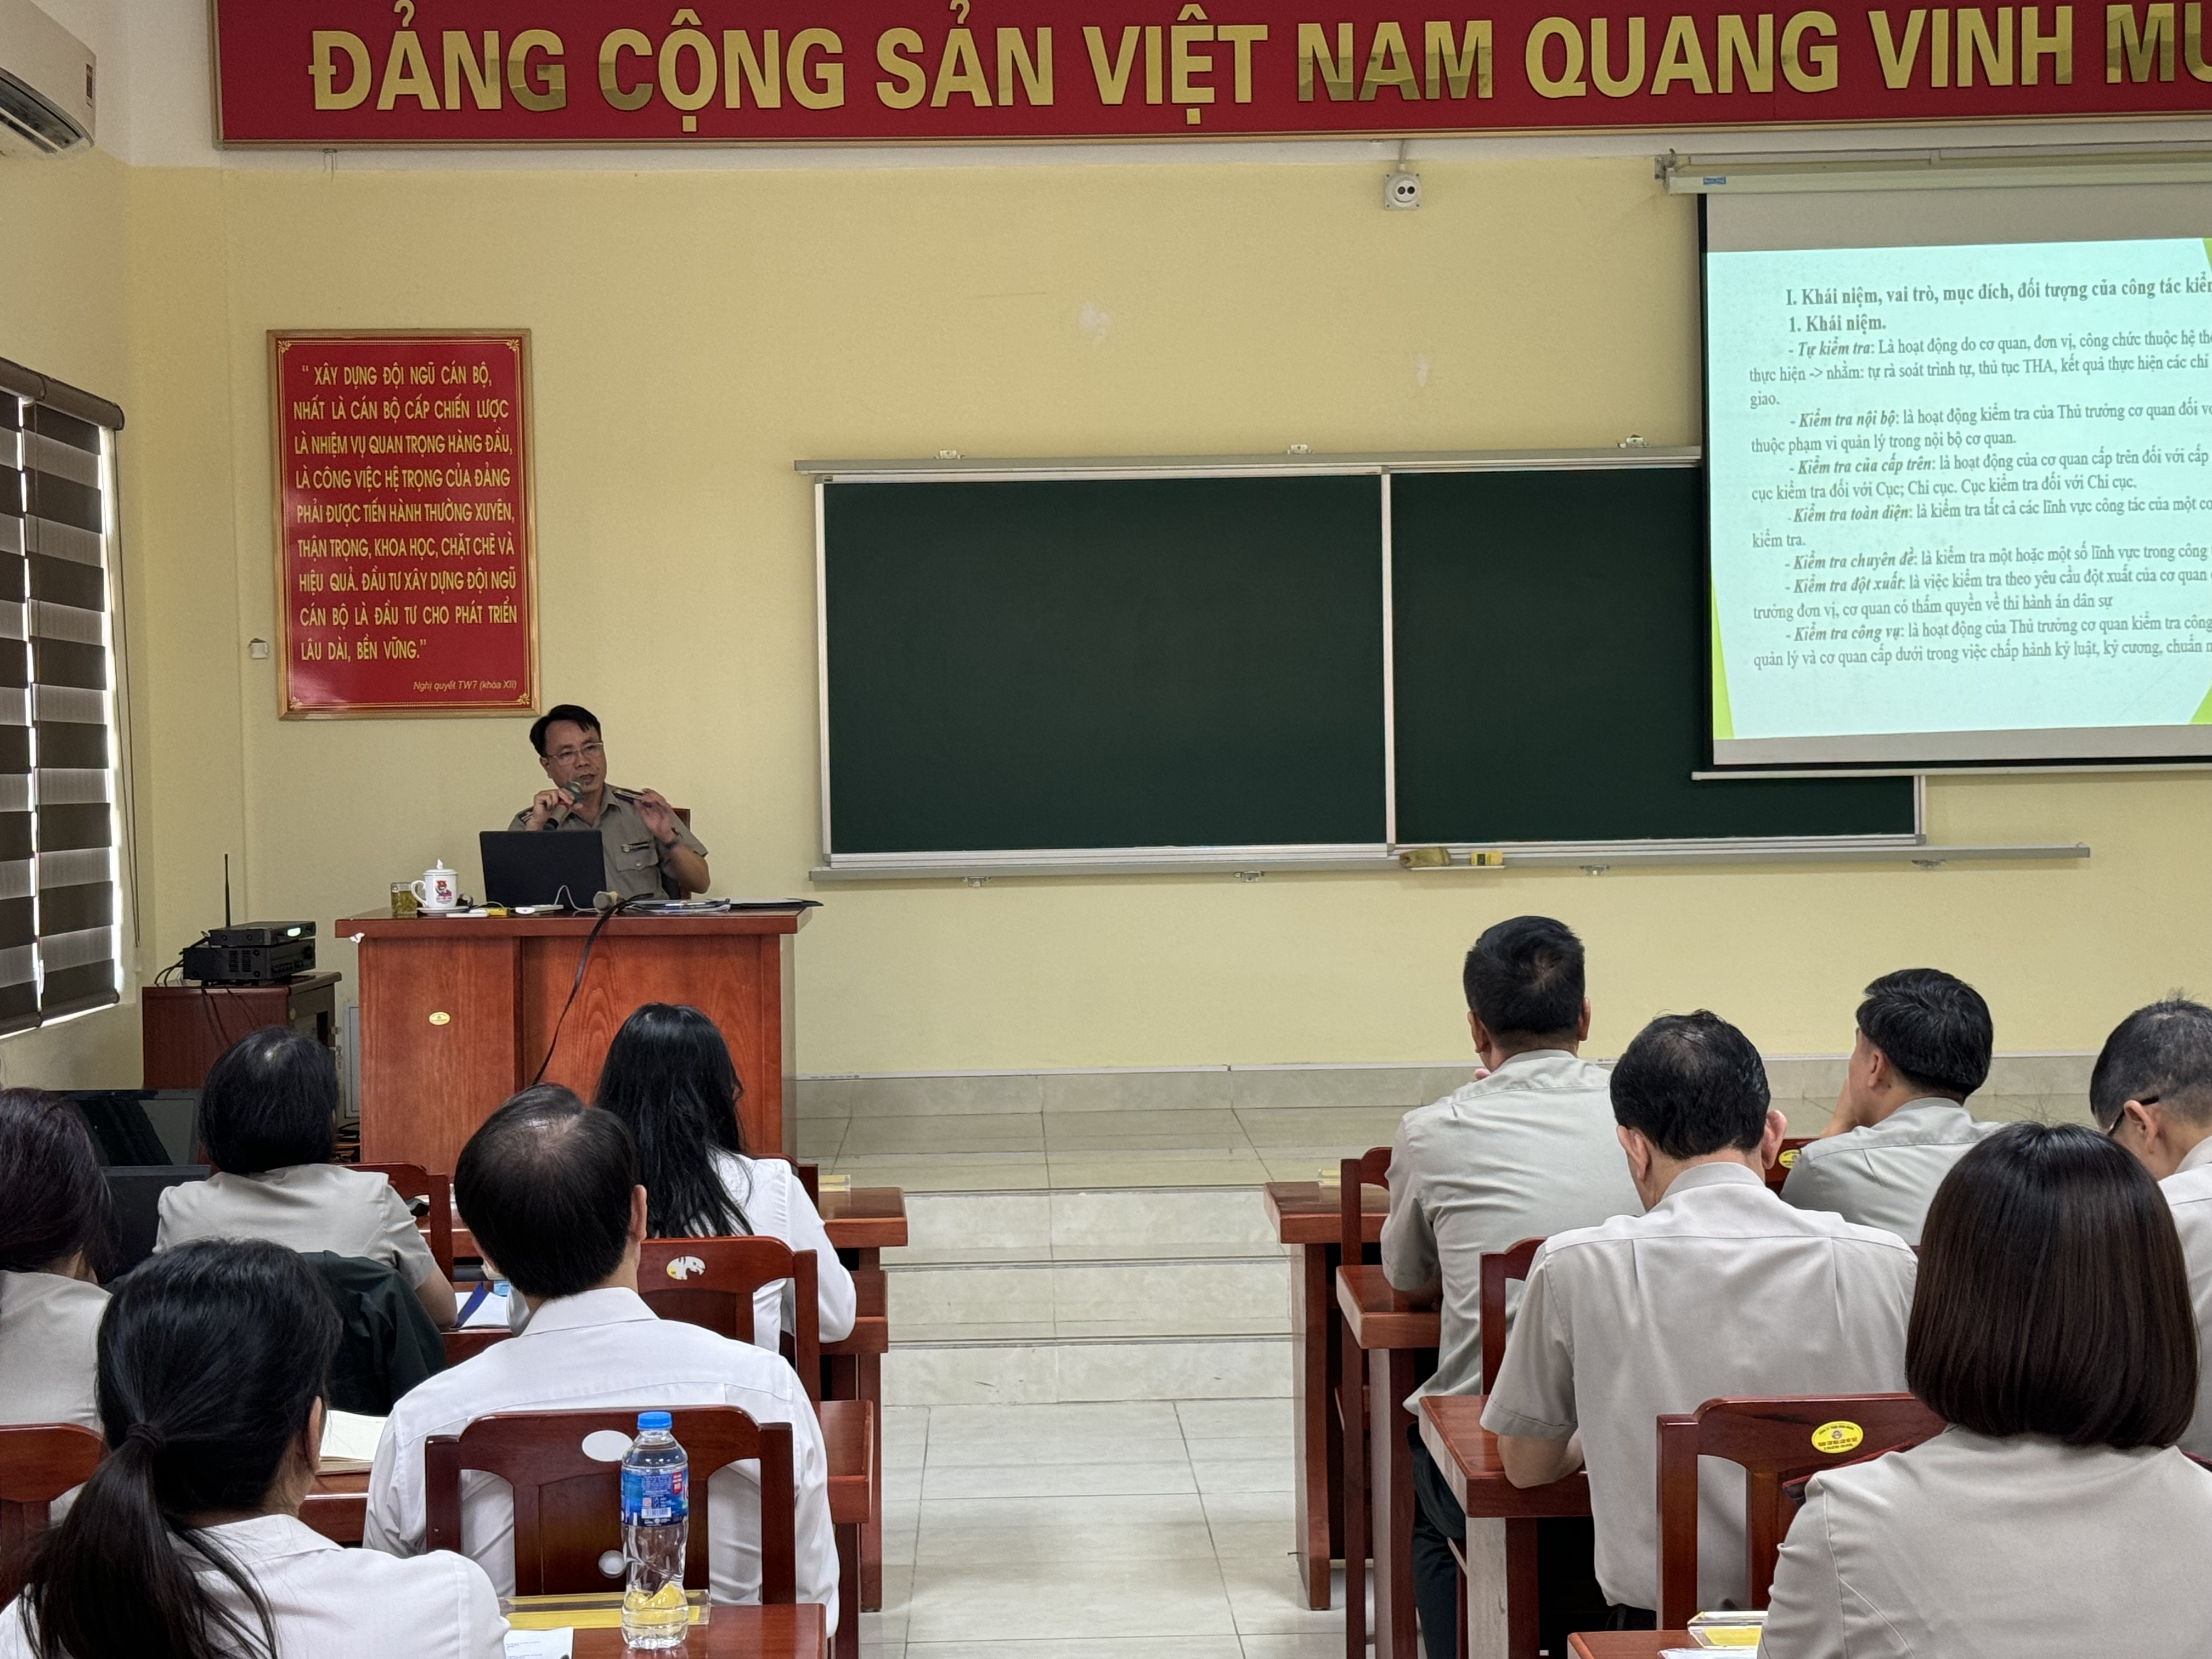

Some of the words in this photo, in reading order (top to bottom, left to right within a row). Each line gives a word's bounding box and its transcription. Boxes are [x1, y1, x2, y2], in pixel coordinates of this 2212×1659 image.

[308, 0, 566, 111] ĐẢNG
[599, 9, 844, 132] CỘNG
[876, 0, 1053, 109] SẢN
[1082, 4, 1268, 124] VIỆT
[1299, 20, 1492, 101] NAM
[1526, 11, 1837, 98] QUANG
[1868, 6, 2072, 88] VINH
[1786, 289, 1797, 306] I.
[1802, 288, 1837, 305] Khái
[1842, 286, 1882, 308] niệm,
[1886, 286, 1908, 302] vai
[1913, 285, 1939, 304] trò,
[1943, 289, 1974, 305] mục
[1978, 283, 2013, 302] đích,
[2018, 277, 2040, 298] đối
[2045, 283, 2088, 302] tượng
[2092, 279, 2116, 296] của
[2121, 278, 2155, 299] công
[2160, 278, 2181, 294] tác
[1790, 317, 1801, 332] 1.
[1806, 315, 1842, 332] Khái
[1846, 314, 1886, 335] niệm.
[314, 362, 338, 385] XÂY
[344, 365, 377, 390] DỰNG
[383, 362, 404, 389] ĐỘI
[410, 362, 435, 385] NGŨ
[441, 360, 466, 385] CÁN
[473, 361, 492, 388] BỘ,
[294, 394, 325, 420] NHẤT
[332, 396, 346, 419] LÀ
[351, 395, 377, 419] CÁN
[383, 397, 400, 424] BỘ
[405, 393, 430, 419] CẤP
[435, 393, 470, 419] CHIẾN
[477, 399, 509, 422] LƯỢC
[295, 430, 309, 454] LÀ
[312, 431, 347, 458] NHIỆM
[350, 436, 366, 458] VỤ
[369, 436, 403, 454] QUAN
[405, 435, 445, 458] TRỌNG
[448, 429, 482, 453] HÀNG
[484, 427, 512, 455] ĐẦU,
[1751, 437, 1785, 455] thuộc
[1788, 437, 1822, 456] phạm
[1825, 435, 1837, 450] vi
[1841, 435, 1871, 454] quản
[1874, 433, 1886, 453] lý
[1889, 436, 1921, 451] trong
[1925, 432, 1943, 449] nội
[1947, 431, 1962, 448] bộ
[1966, 435, 1981, 445] cơ
[296, 465, 311, 489] LÀ
[313, 466, 352, 489] CÔNG
[354, 465, 381, 492] VIỆC
[385, 465, 399, 492] HỆ
[402, 469, 443, 492] TRỌNG
[445, 462, 472, 487] CỦA
[474, 461, 510, 487] ĐẢNG
[1752, 490, 1773, 503] cục
[1776, 480, 1807, 500] kiểm
[1810, 486, 1826, 498] tra
[1830, 478, 1849, 498] đối
[1853, 481, 1872, 496] với
[1908, 479, 1929, 495] Chi
[1961, 478, 1985, 495] Cục
[1989, 473, 2019, 492] kiểm
[2023, 479, 2038, 491] tra
[2041, 471, 2061, 490] đối
[2064, 475, 2084, 490] với
[2087, 474, 2109, 489] Chi
[297, 498, 324, 523] PHẢI
[326, 503, 361, 527] ĐƯỢC
[363, 497, 386, 522] TIẾN
[389, 498, 421, 522] HÀNH
[424, 498, 472, 522] THƯỜNG
[475, 498, 515, 523] XUYÊN,
[297, 535, 327, 562] THẬN
[329, 538, 371, 562] TRỌNG,
[375, 538, 407, 556] KHOA
[410, 538, 438, 561] HỌC,
[441, 533, 471, 560] CHẶT
[473, 533, 495, 555] CHẼ
[498, 531, 515, 555] VÀ
[1752, 528, 1783, 548] kiểm
[299, 569, 323, 596] HIỆU
[330, 566, 358, 591] QUẢ.
[362, 565, 386, 591] ĐẦU
[388, 571, 401, 590] TƯ
[404, 568, 427, 590] XÂY
[431, 571, 464, 594] DỰNG
[467, 567, 488, 594] ĐỘI
[491, 566, 516, 589] NGŨ
[300, 602, 326, 626] CÁN
[332, 603, 348, 630] BỘ
[355, 601, 369, 625] LÀ
[374, 600, 398, 625] ĐẦU
[404, 605, 417, 624] TƯ
[423, 606, 449, 624] CHO
[455, 600, 482, 624] PHÁT
[488, 596, 517, 623] TRIỂN
[1753, 603, 1793, 622] trưởng
[1797, 603, 1820, 618] đơn
[1843, 606, 1858, 616] cơ
[1861, 604, 1891, 619] quan
[1894, 599, 1908, 614] có
[1912, 594, 1942, 613] thẩm
[1945, 592, 1982, 617] quyền
[1985, 591, 2000, 611] về
[2004, 595, 2019, 610] thi
[2023, 594, 2052, 610] hành
[2056, 594, 2070, 608] án
[2073, 593, 2095, 607] dân
[2098, 596, 2113, 610] sự
[301, 637, 321, 660] LÂU
[328, 635, 351, 662] DÀI,
[357, 634, 377, 659] BỀN
[1754, 651, 1784, 670] quản
[1787, 650, 1799, 669] lý
[1802, 650, 1816, 664] và
[1820, 654, 1835, 664] cơ
[1838, 653, 1867, 667] quan
[1871, 643, 1892, 666] cấp
[1896, 645, 1923, 661] dưới
[1927, 648, 1959, 663] trong
[1962, 644, 1987, 661] việc
[1990, 639, 2019, 662] chấp
[2022, 642, 2052, 657] hành
[2055, 641, 2070, 659] kỷ
[2103, 639, 2119, 658] kỷ
[2166, 634, 2203, 653] chuẩn
[413, 681, 432, 692] Nghị
[434, 680, 456, 692] quyết
[458, 680, 477, 690] TW7
